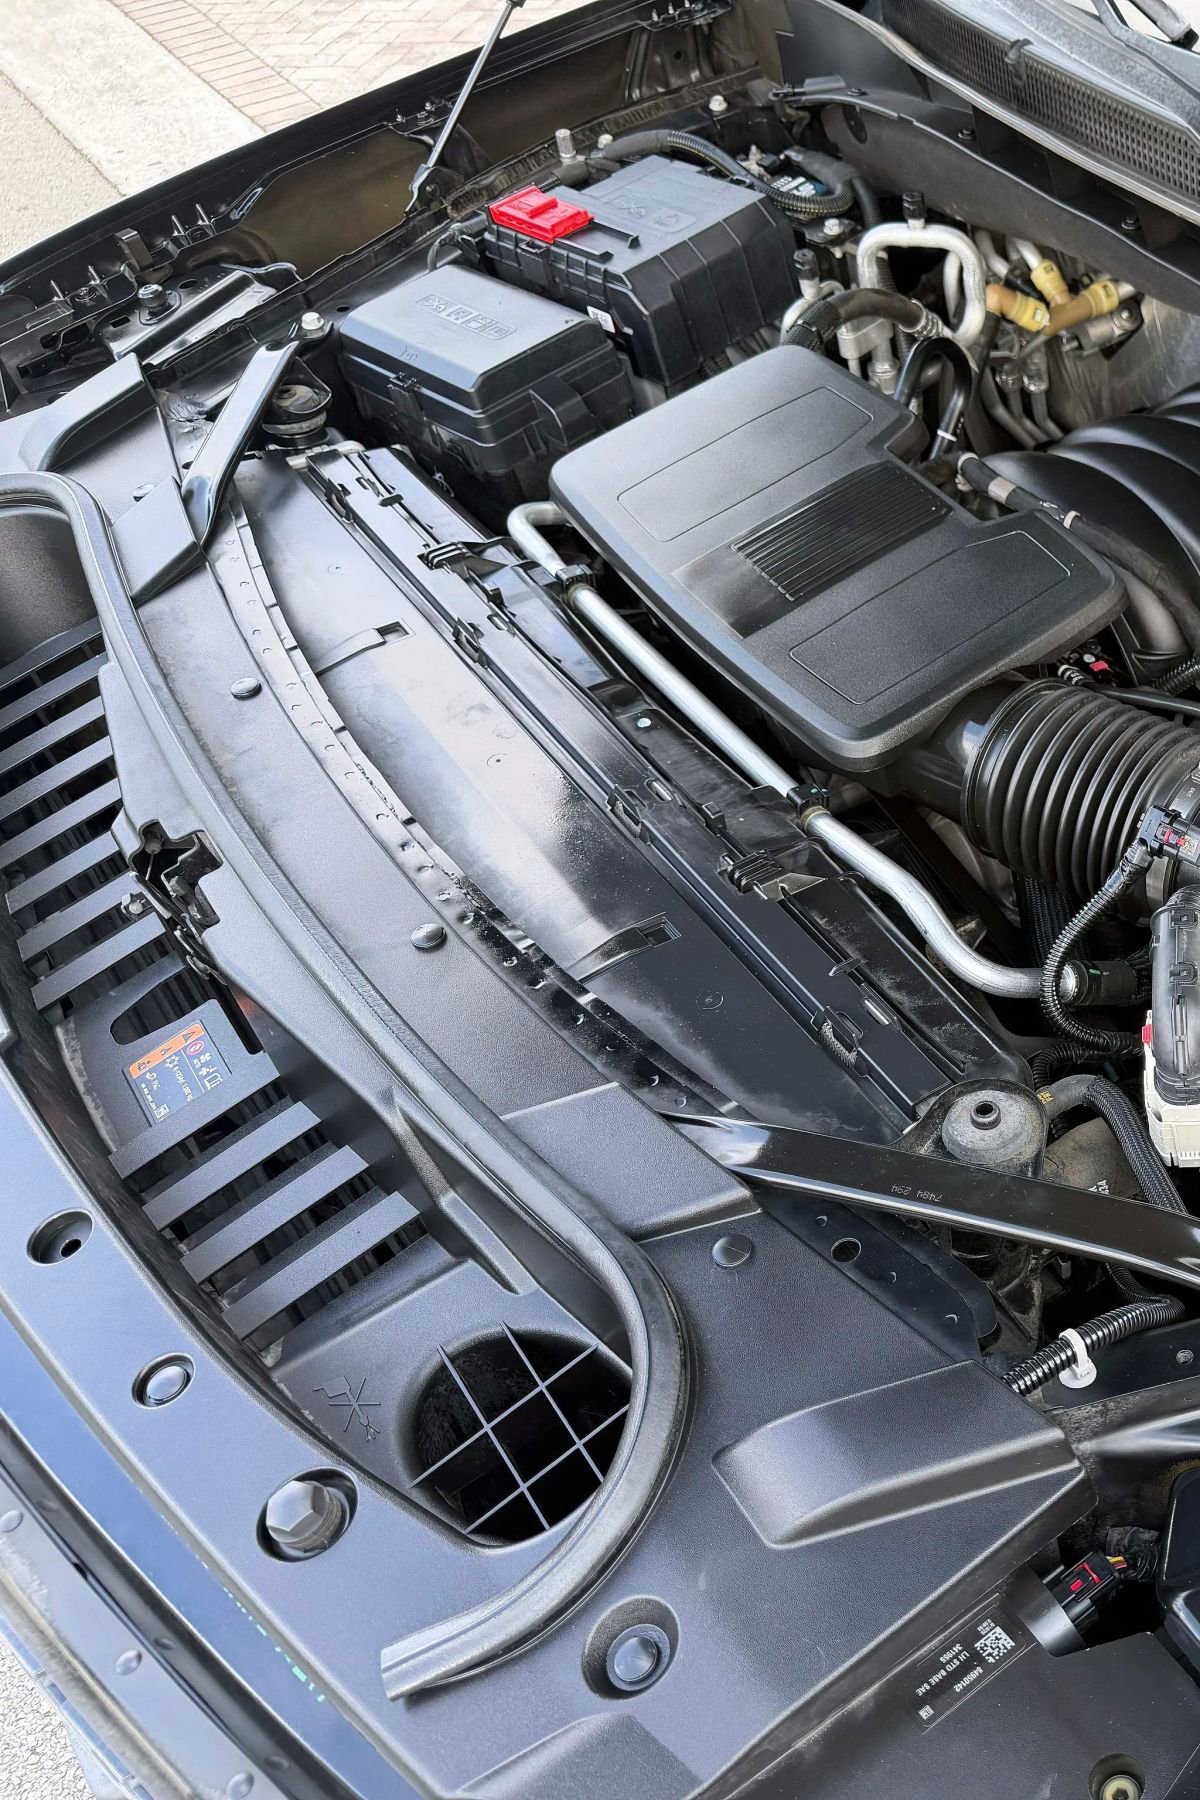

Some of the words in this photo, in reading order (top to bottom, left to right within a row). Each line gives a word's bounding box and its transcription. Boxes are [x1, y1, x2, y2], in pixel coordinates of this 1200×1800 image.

[957, 1650, 970, 1662] LH
[946, 1658, 960, 1672] STD
[929, 1668, 948, 1686] BASE
[916, 1683, 931, 1696] SAE
